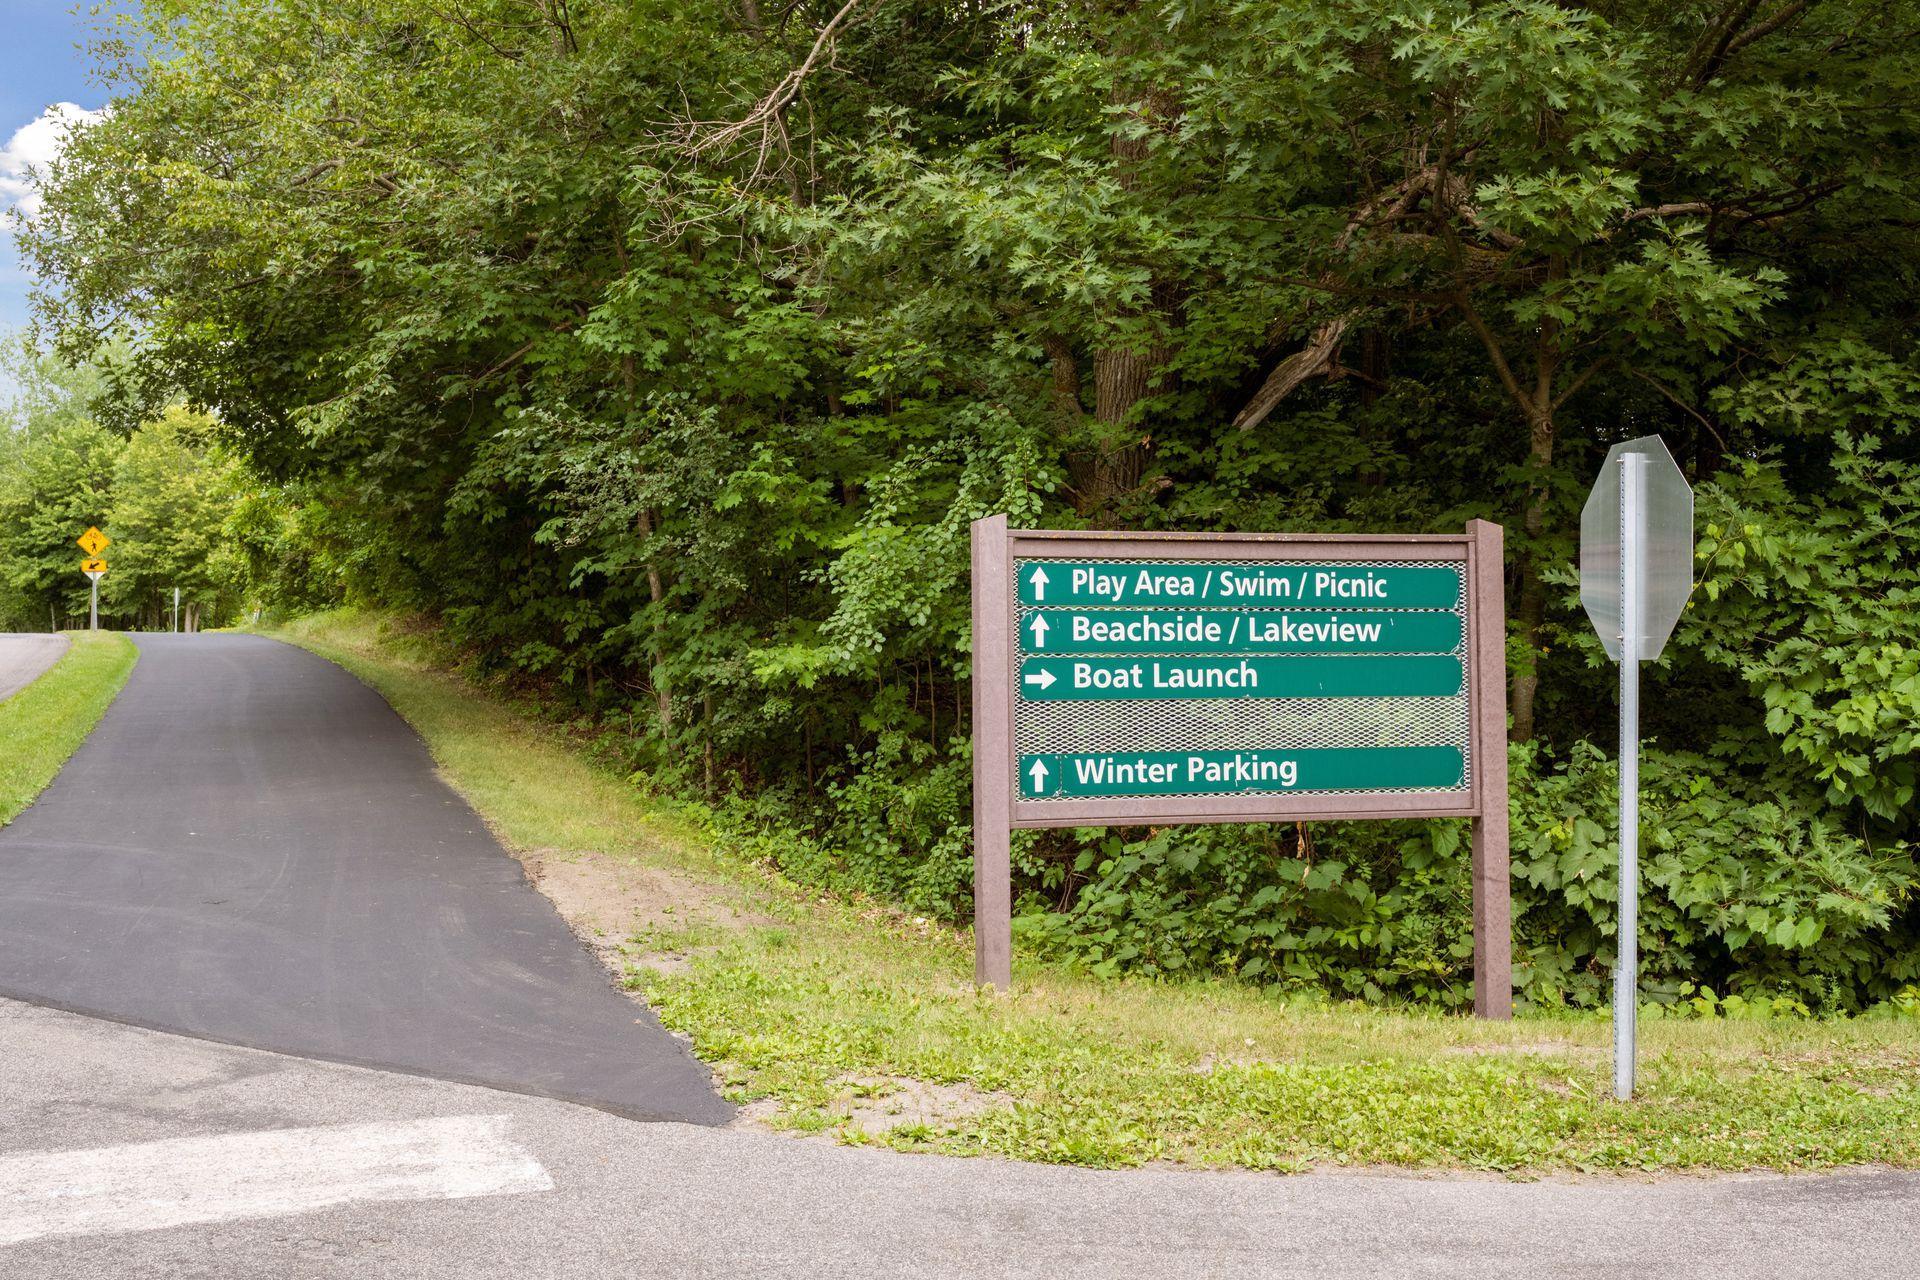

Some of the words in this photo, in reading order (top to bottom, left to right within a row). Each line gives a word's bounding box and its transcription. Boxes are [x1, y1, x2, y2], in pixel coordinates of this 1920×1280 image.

[1073, 568, 1126, 601] Play
[1134, 570, 1194, 595] Area
[1220, 571, 1290, 596] Swim
[1316, 572, 1387, 597] Picnic
[1073, 616, 1221, 641] Beachside
[1250, 616, 1381, 642] Lakeview
[1075, 663, 1142, 688] Boat
[1154, 661, 1257, 688] Launch
[1075, 758, 1177, 784] Winter
[1188, 755, 1297, 786] Parking
